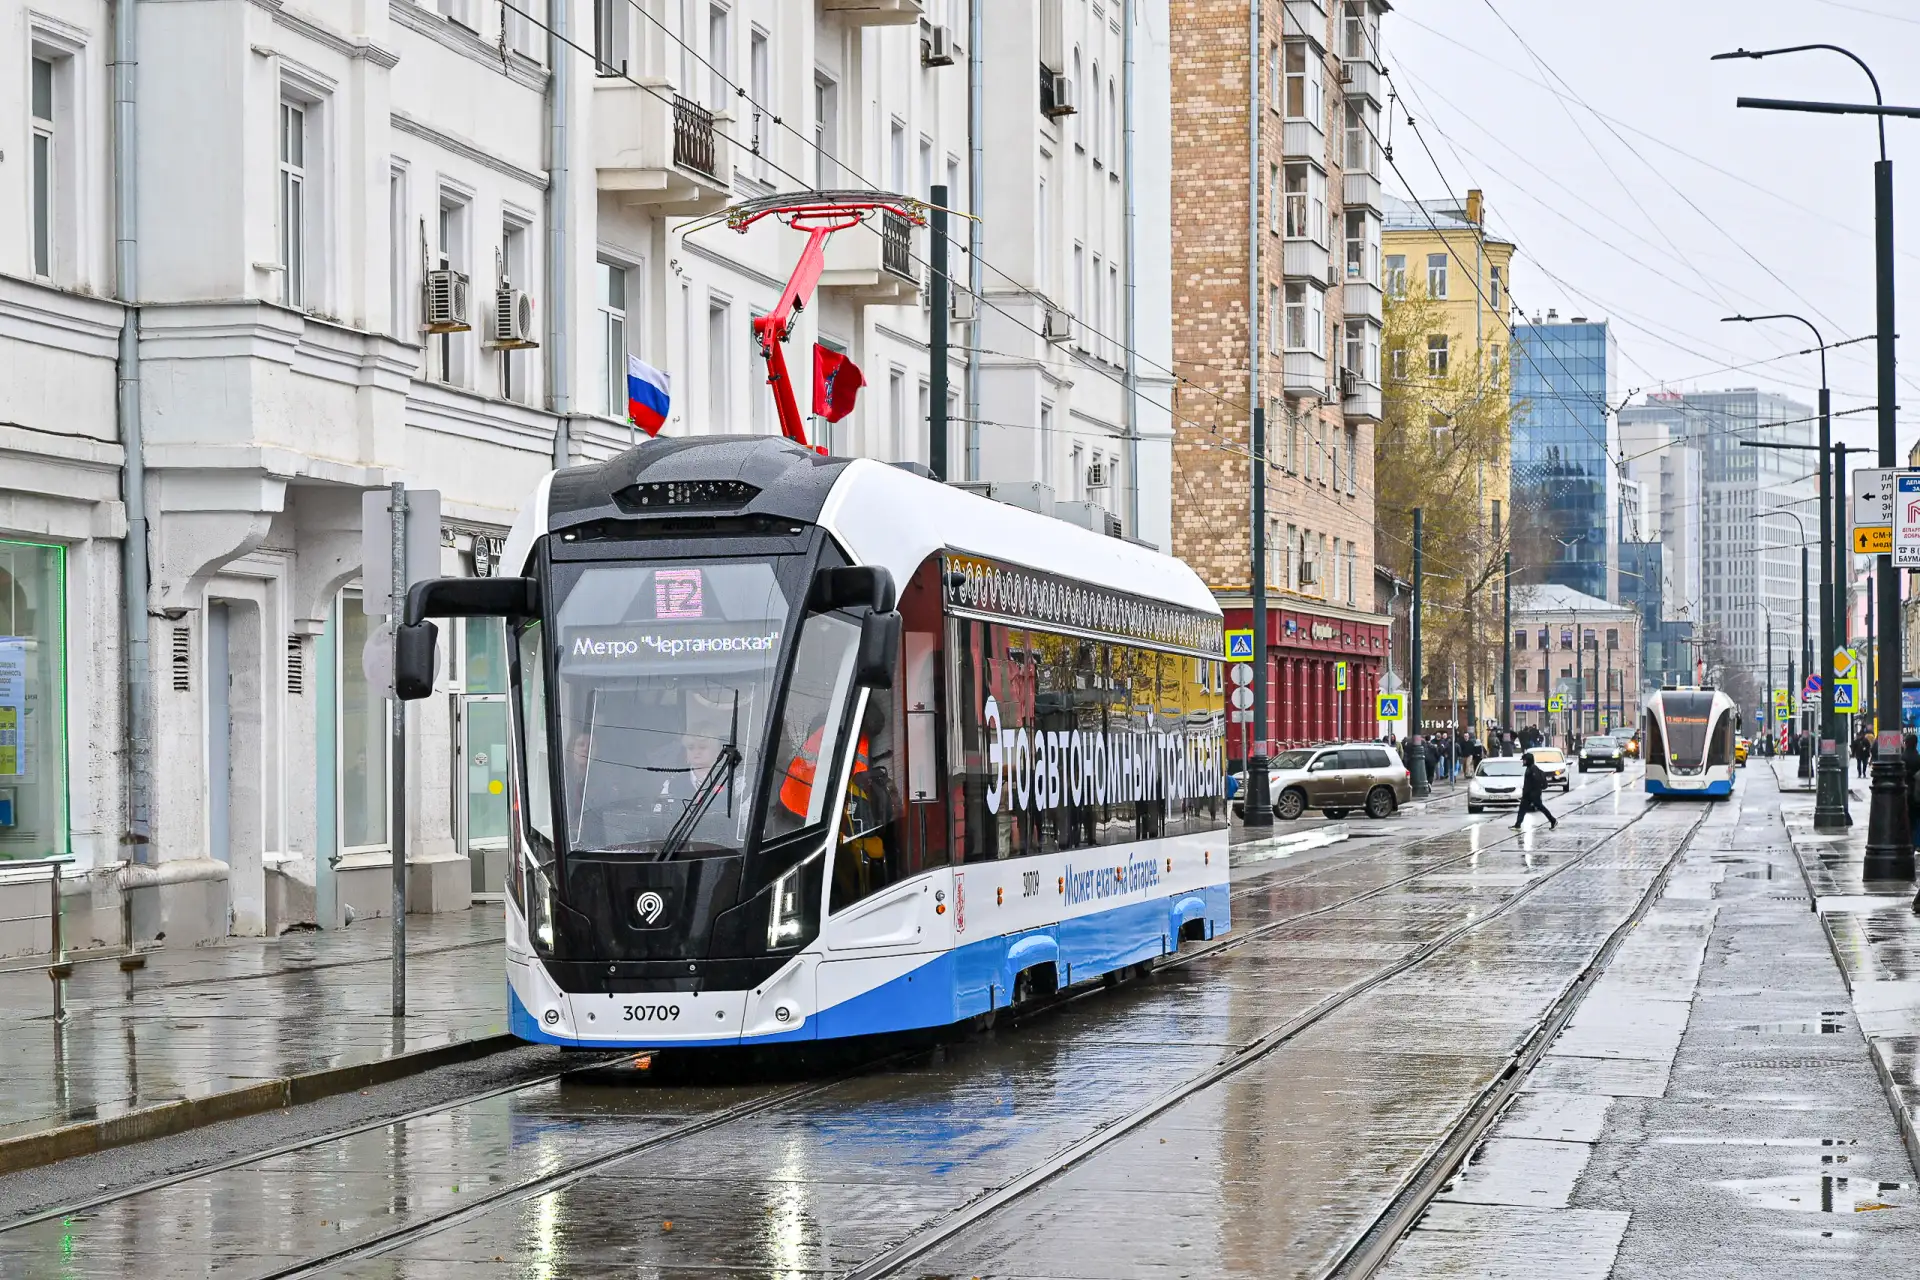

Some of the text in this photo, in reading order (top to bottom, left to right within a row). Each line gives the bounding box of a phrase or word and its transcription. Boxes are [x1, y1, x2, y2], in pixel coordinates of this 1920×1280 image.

[573, 631, 779, 658] Метро "Чертановская"
[984, 695, 1031, 815] Это
[1034, 703, 1158, 812] автономный
[1064, 863, 1095, 907] Может
[1096, 865, 1118, 899] ехать
[1128, 851, 1161, 898] батарее.
[622, 1004, 681, 1021] 30709
